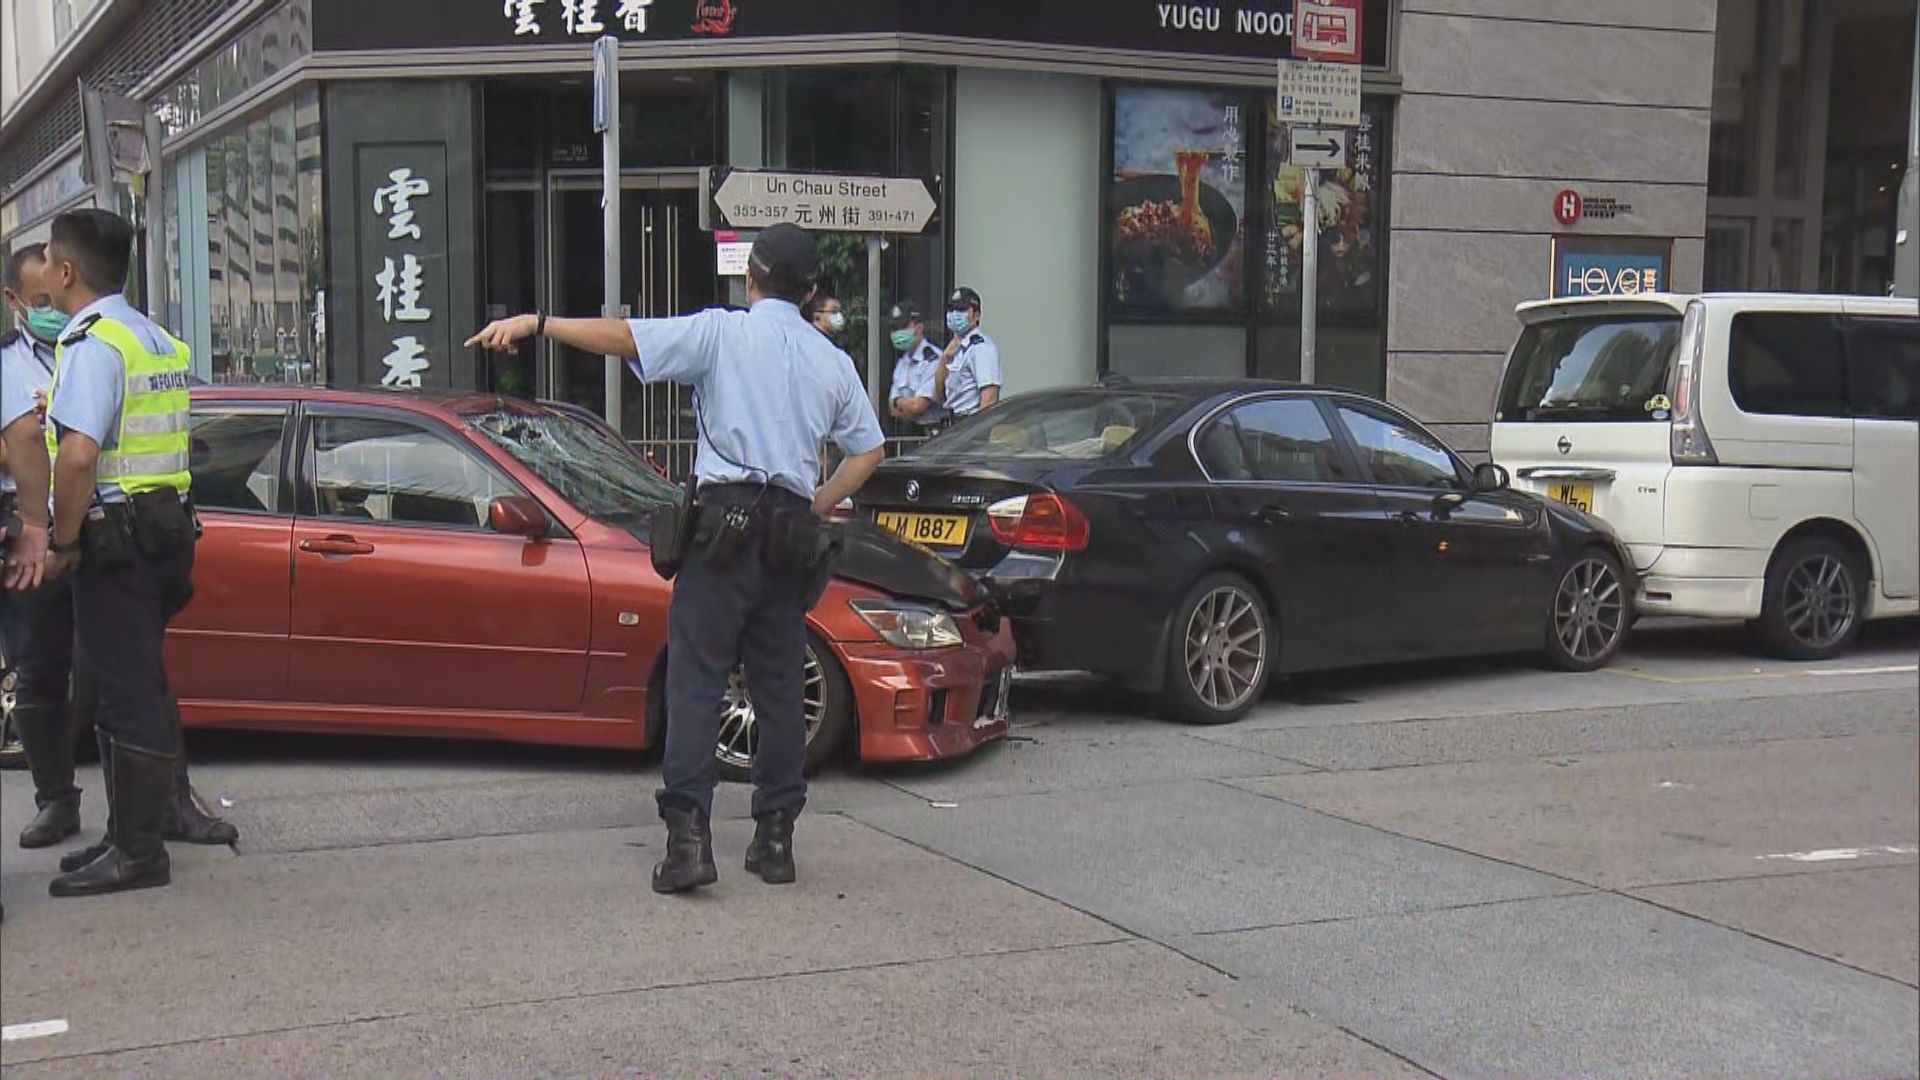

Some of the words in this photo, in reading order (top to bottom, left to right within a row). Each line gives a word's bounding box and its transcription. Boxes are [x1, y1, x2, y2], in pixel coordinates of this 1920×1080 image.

[1158, 4, 1221, 32] YUGU
[766, 176, 788, 195] Un
[793, 180, 833, 197] Chau
[838, 183, 887, 198] Street
[733, 204, 789, 219] 353-357
[794, 203, 861, 226] 元州街
[867, 209, 916, 223] 391-471
[1560, 483, 1579, 505] WL
[914, 517, 958, 540] 1887
